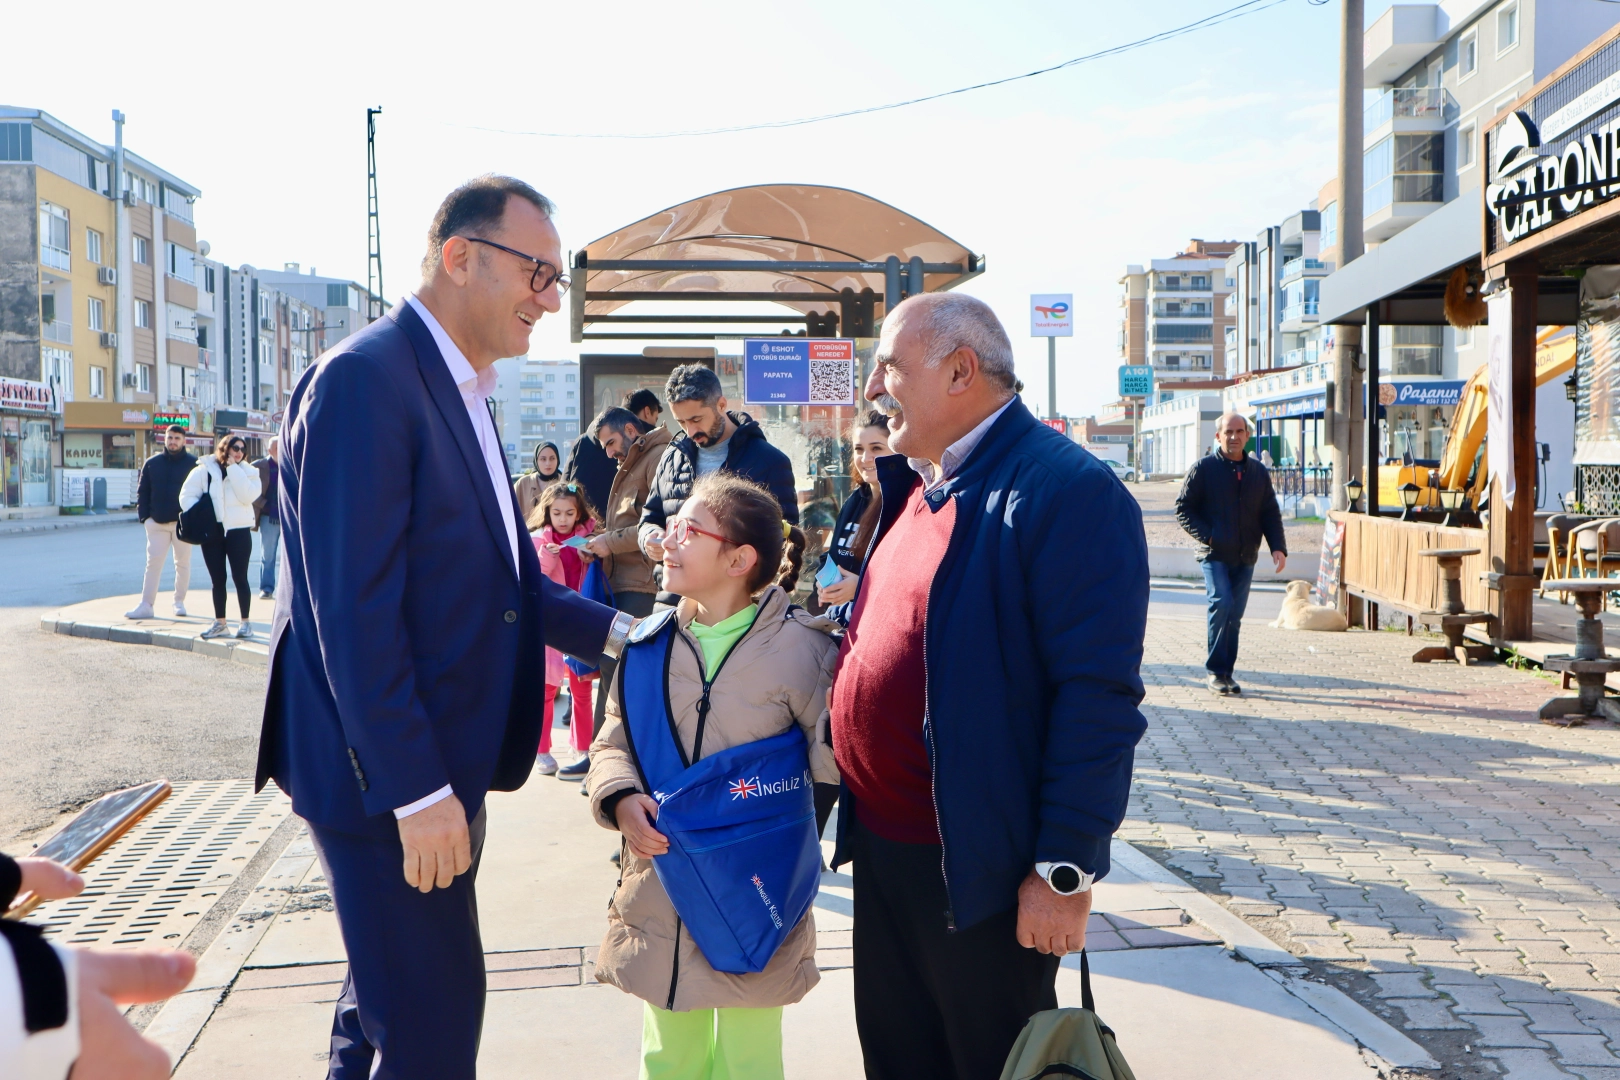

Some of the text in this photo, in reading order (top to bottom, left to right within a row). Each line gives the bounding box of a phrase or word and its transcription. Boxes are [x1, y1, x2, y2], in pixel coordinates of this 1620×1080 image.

[1566, 101, 1583, 121] Steak
[1583, 91, 1602, 111] House
[1604, 83, 1609, 97] &
[778, 353, 802, 361] DURAĞI
[1400, 384, 1459, 402] Paşanın
[65, 448, 103, 459] KAHVE
[756, 776, 800, 796] İNGİLİZ
